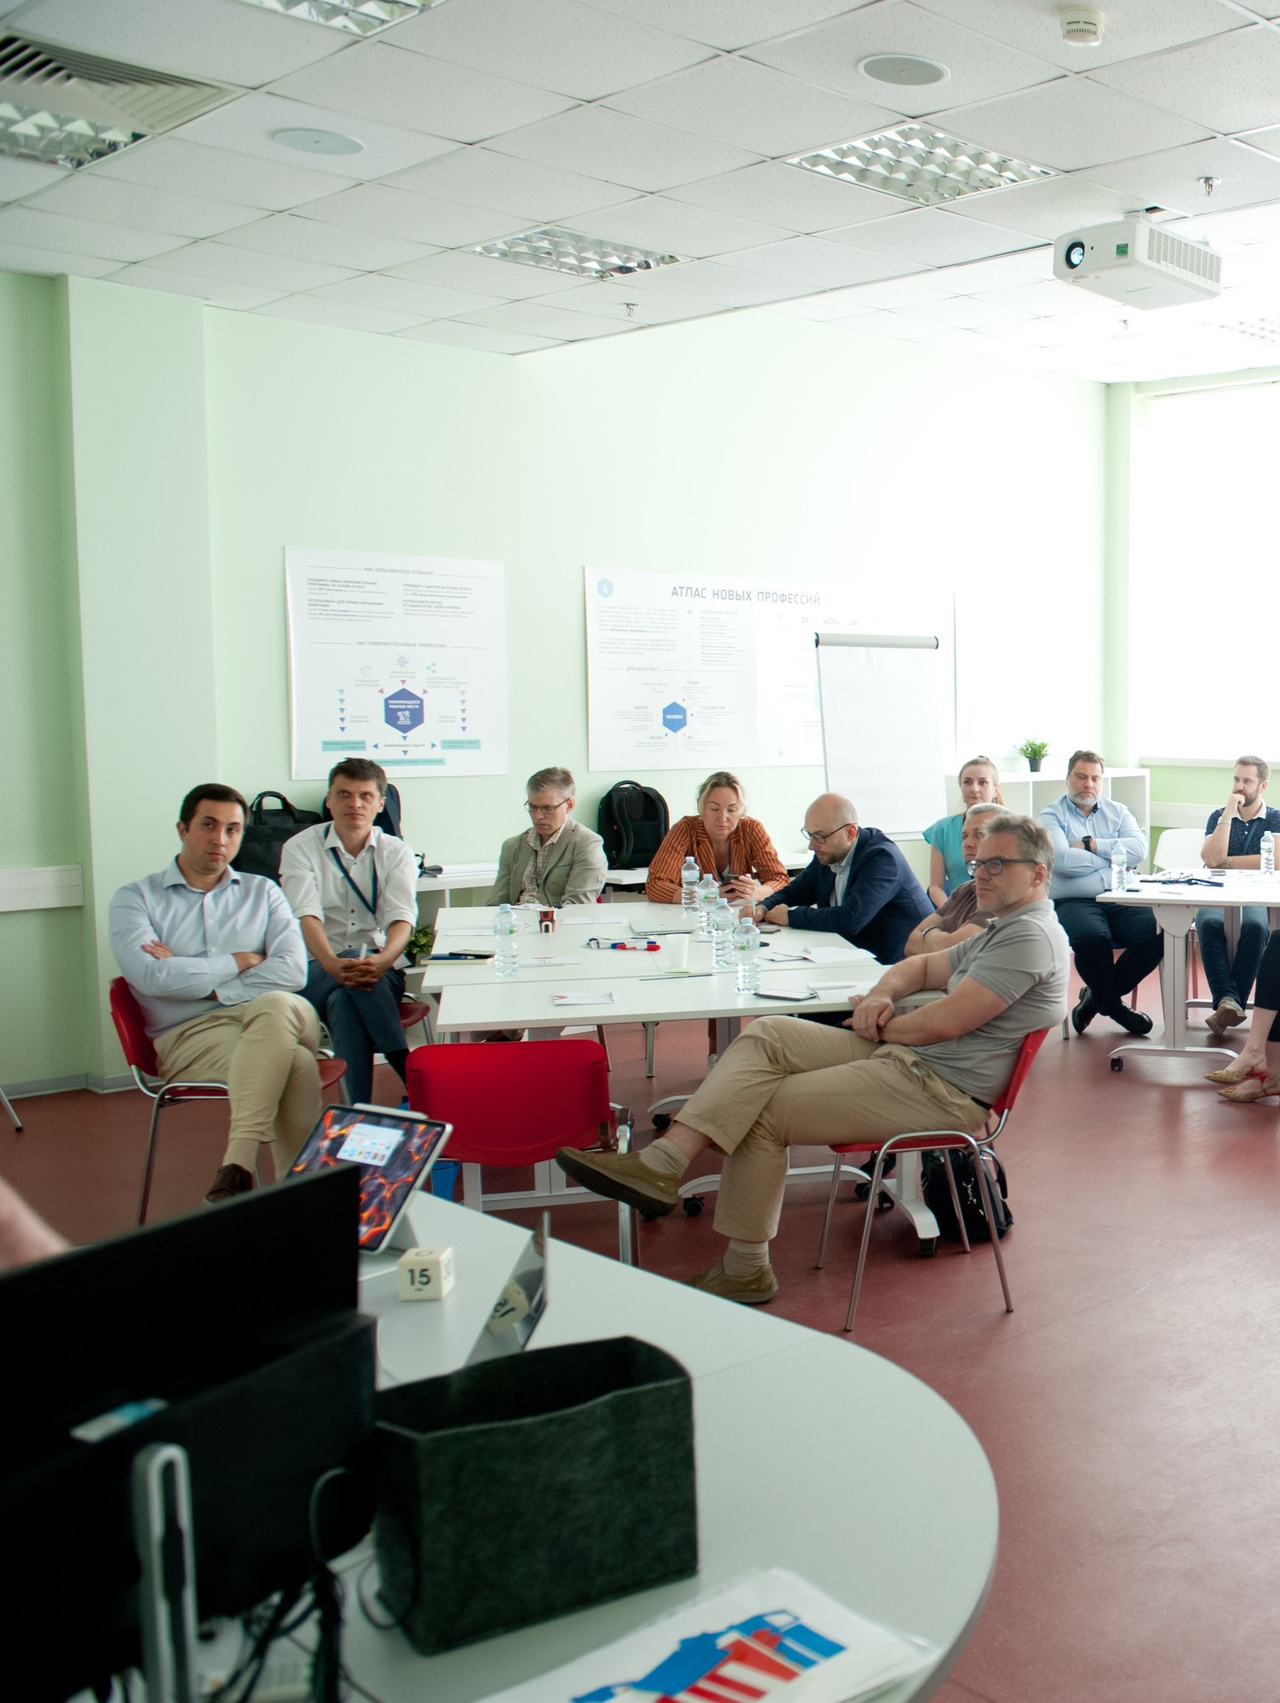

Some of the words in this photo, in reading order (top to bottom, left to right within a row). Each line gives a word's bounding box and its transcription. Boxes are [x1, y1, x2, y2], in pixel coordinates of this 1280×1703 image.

[671, 586, 707, 599] АТЛАС
[712, 588, 752, 601] НОВЫХ
[757, 591, 820, 605] ПРОФЕССИЙ
[408, 1268, 431, 1286] 15
